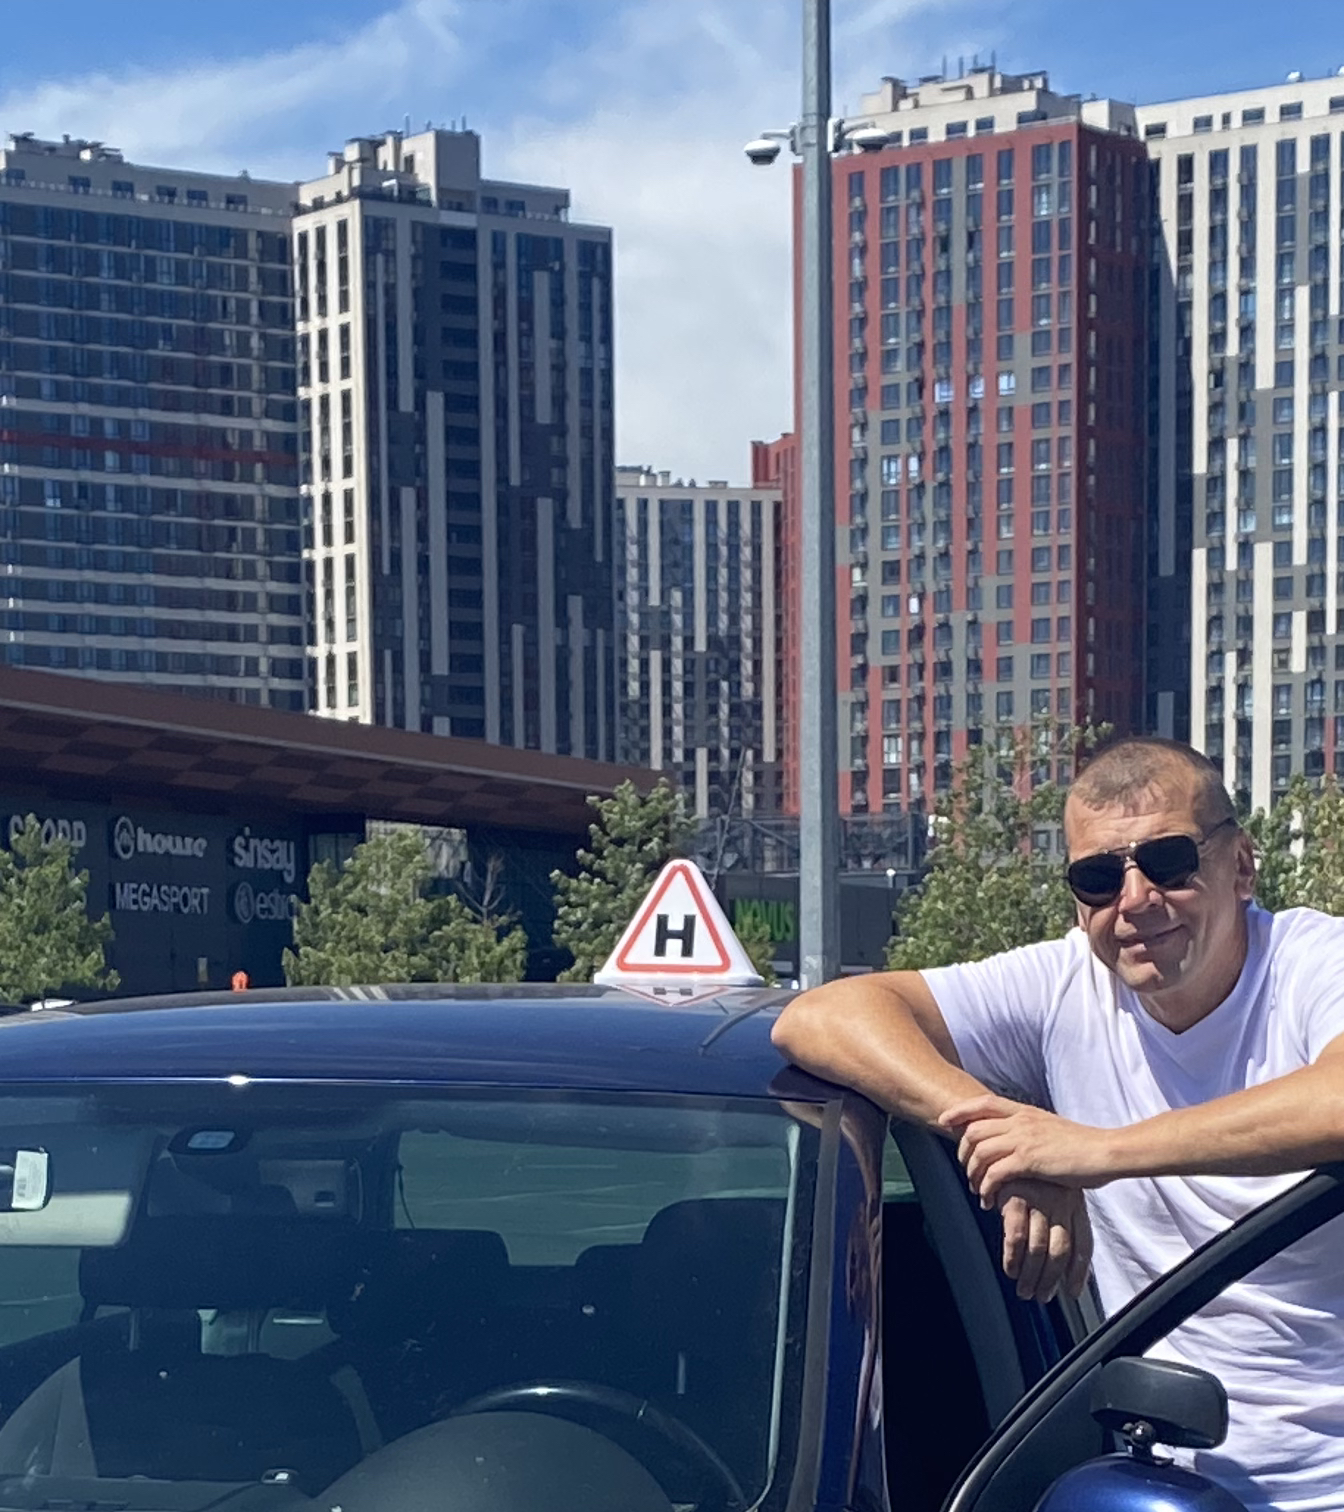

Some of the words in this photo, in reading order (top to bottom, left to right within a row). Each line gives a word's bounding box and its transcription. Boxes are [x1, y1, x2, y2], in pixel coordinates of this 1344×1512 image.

[9, 815, 86, 849] COPP
[234, 827, 296, 883] sinsay
[115, 883, 210, 914] MEGASPORT
[735, 899, 794, 941] NOVUS
